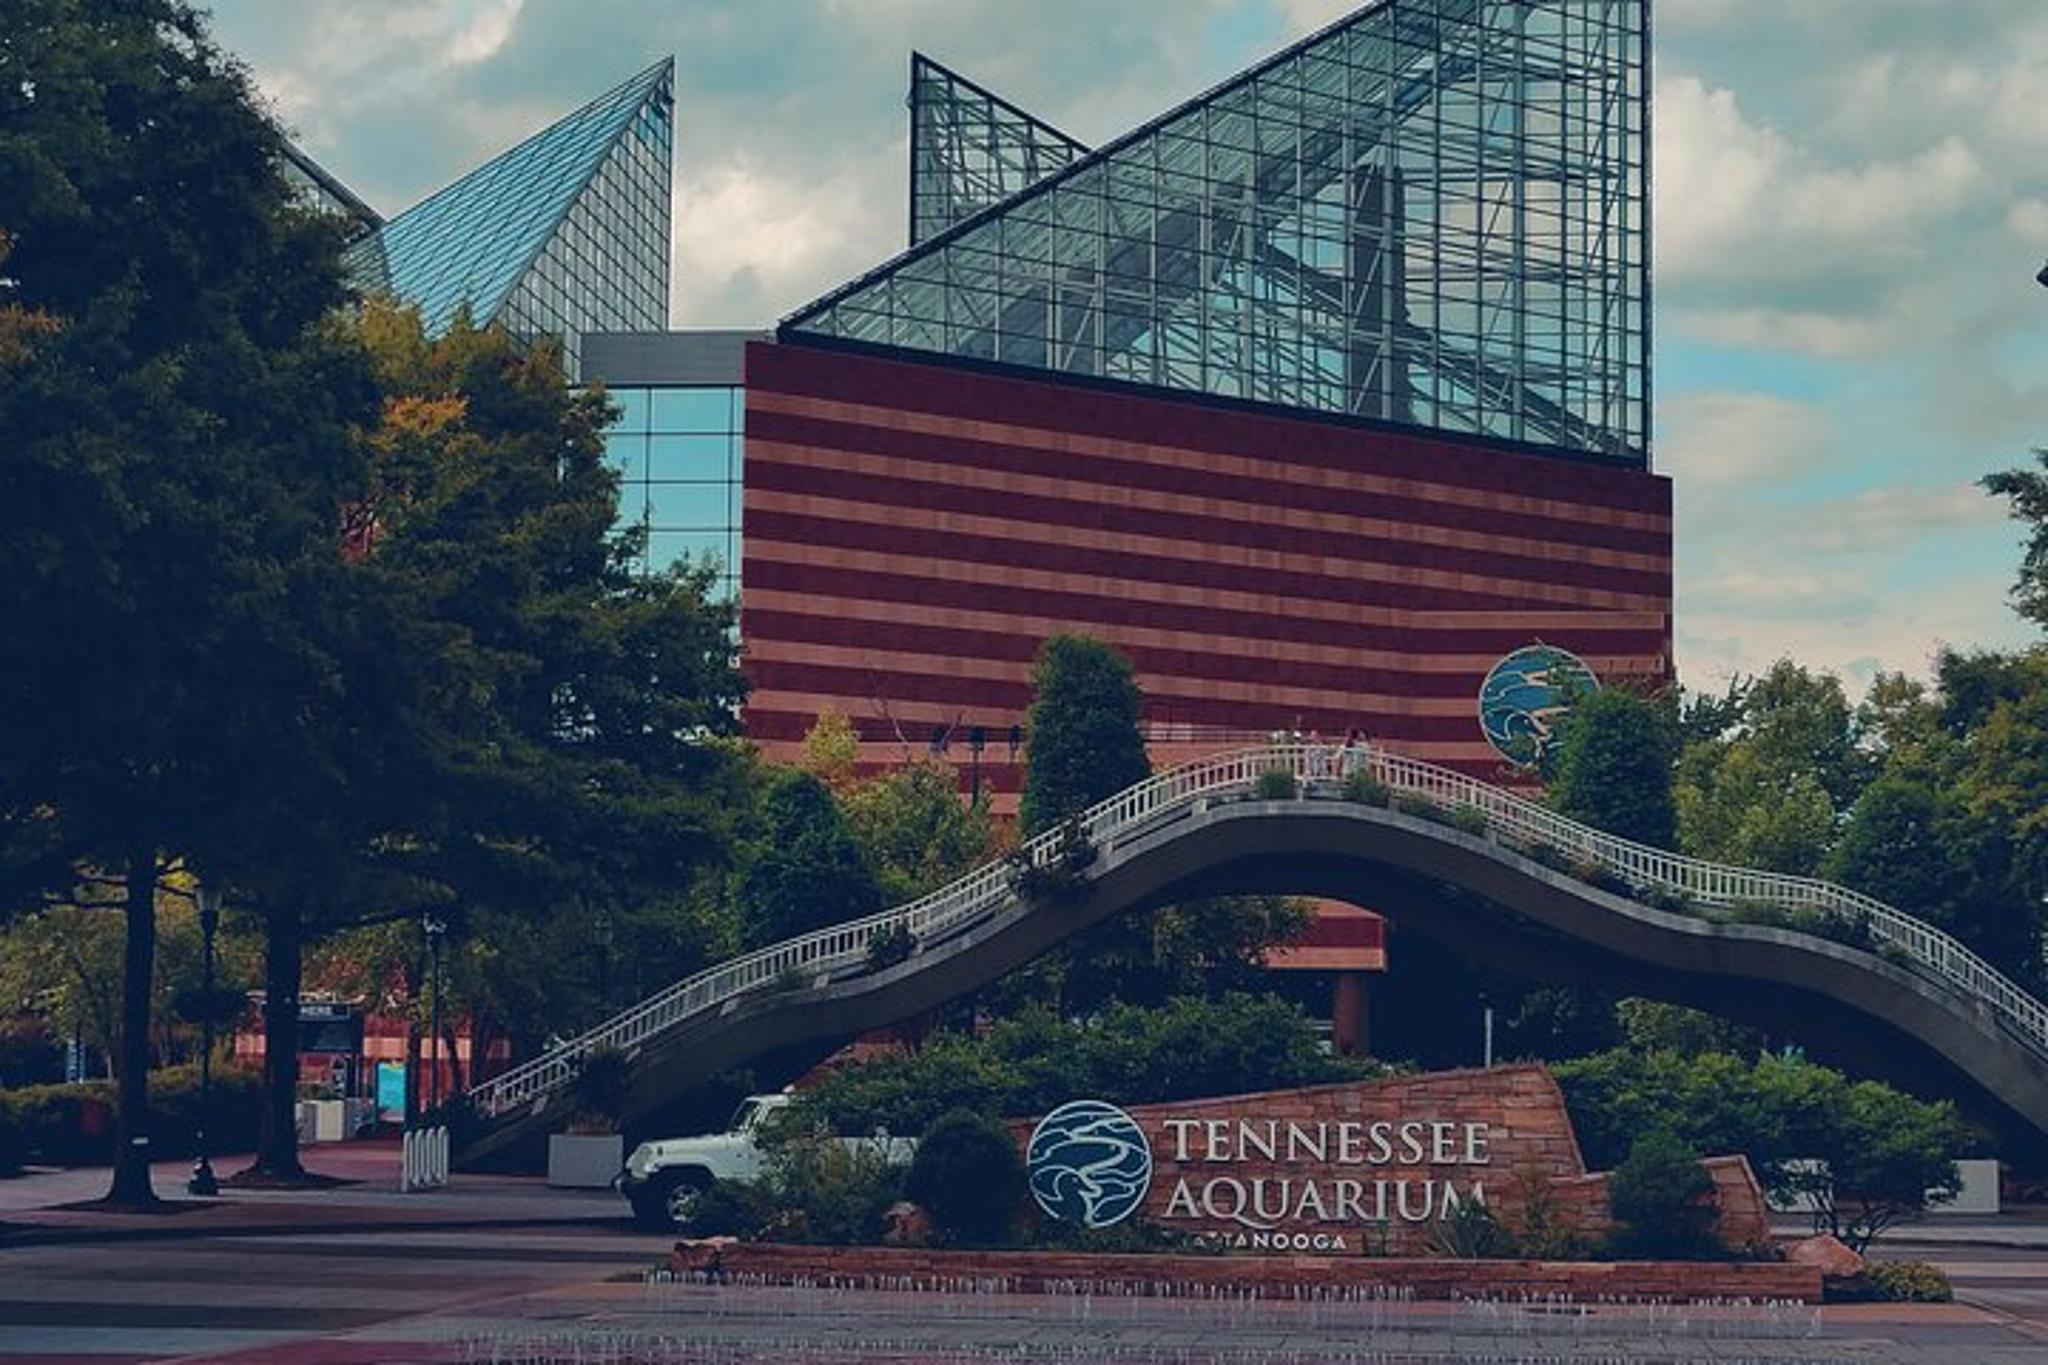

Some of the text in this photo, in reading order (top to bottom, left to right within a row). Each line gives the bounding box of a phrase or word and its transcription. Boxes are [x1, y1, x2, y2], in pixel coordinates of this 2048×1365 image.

[1163, 1119, 1490, 1165] TENNESSEE
[1161, 1177, 1488, 1229] AQUARIUM
[1161, 1231, 1347, 1249] ATANOOGA
